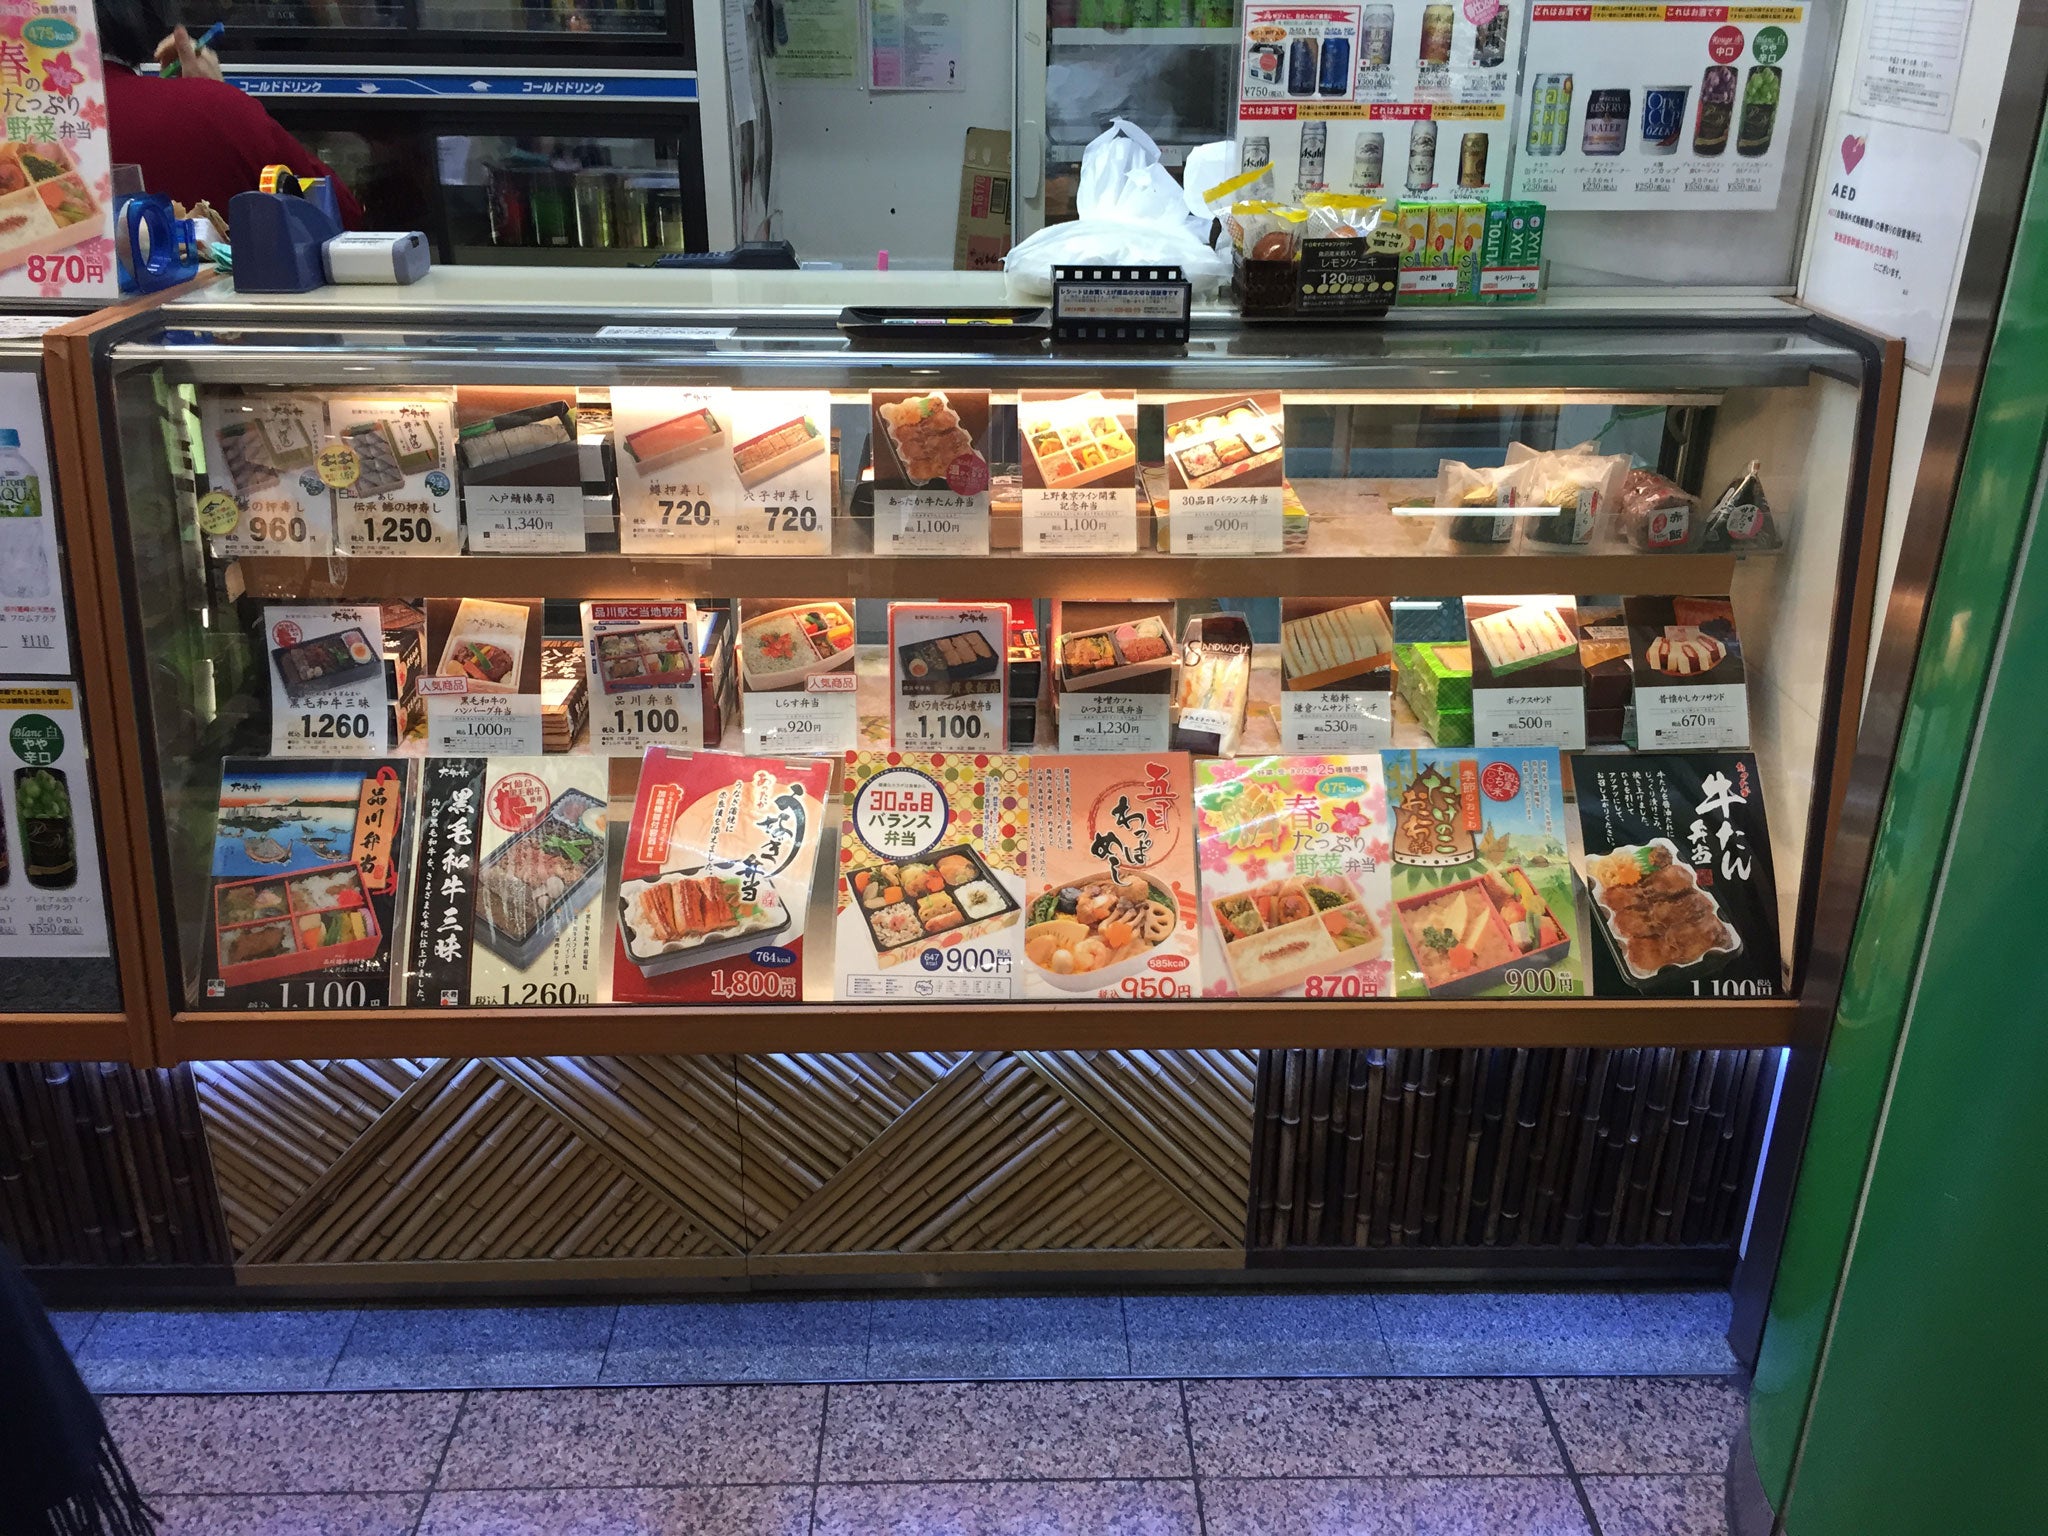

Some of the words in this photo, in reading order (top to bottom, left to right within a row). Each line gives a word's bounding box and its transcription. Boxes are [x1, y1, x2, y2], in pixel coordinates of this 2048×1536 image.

[1534, 7, 1589, 17] これはお酒です
[1667, 8, 1722, 17] これはお酒です
[1760, 45, 1777, 53] やや
[1759, 54, 1777, 62] 辛口
[239, 81, 322, 94] コールドドリンク
[522, 82, 605, 95] コールドドリンク
[2, 87, 80, 117] たっぷり
[1240, 107, 1295, 116] これはお酒です
[1371, 107, 1427, 116] これはお酒です
[1591, 123, 1621, 132] WATER
[1831, 182, 1857, 201] AED
[1321, 257, 1377, 268] レモンケーキ
[1320, 272, 1376, 284] 120円(税込)
[377, 493, 395, 501] あじ
[743, 489, 815, 501] 穴子押寿し
[1041, 491, 1117, 502] 上野東京ライン開業
[1182, 495, 1269, 506] 30品目バランス弁当
[353, 502, 377, 513] 伝承
[889, 496, 974, 508] あったか牛たん弁当
[1060, 501, 1098, 512] 記念弁当
[1668, 511, 1683, 541] 赤飯
[595, 606, 684, 618] 品川駅ご当地駅弁
[22, 634, 50, 648] ¥110
[419, 679, 468, 692] 人気商品
[809, 677, 854, 689] 人気商品
[461, 696, 507, 706] 黒毛和牛の
[614, 694, 674, 706] 品川弁当
[775, 698, 820, 709] しらす弁当
[1320, 693, 1350, 703] 大船軒
[1506, 695, 1553, 705] ボックスサンド
[1659, 692, 1726, 703] 昔懐かしカツサンド
[454, 706, 512, 717] ハンバーグ弁当
[12, 728, 43, 738] Blanc
[45, 726, 57, 737] 白
[22, 739, 48, 749] やや
[24, 751, 51, 764] 辛口
[870, 791, 933, 812] 30品目
[1462, 769, 1478, 829] 季節のおこわ
[868, 812, 932, 829] バランス
[1694, 770, 1752, 881] 牛たん
[358, 787, 388, 874] 品川弁当
[884, 830, 916, 846] 弁当
[1293, 829, 1366, 853] たっぷり
[1687, 819, 1713, 865] 弁当
[923, 953, 939, 962] 647
[1149, 956, 1187, 969] 585kcal
